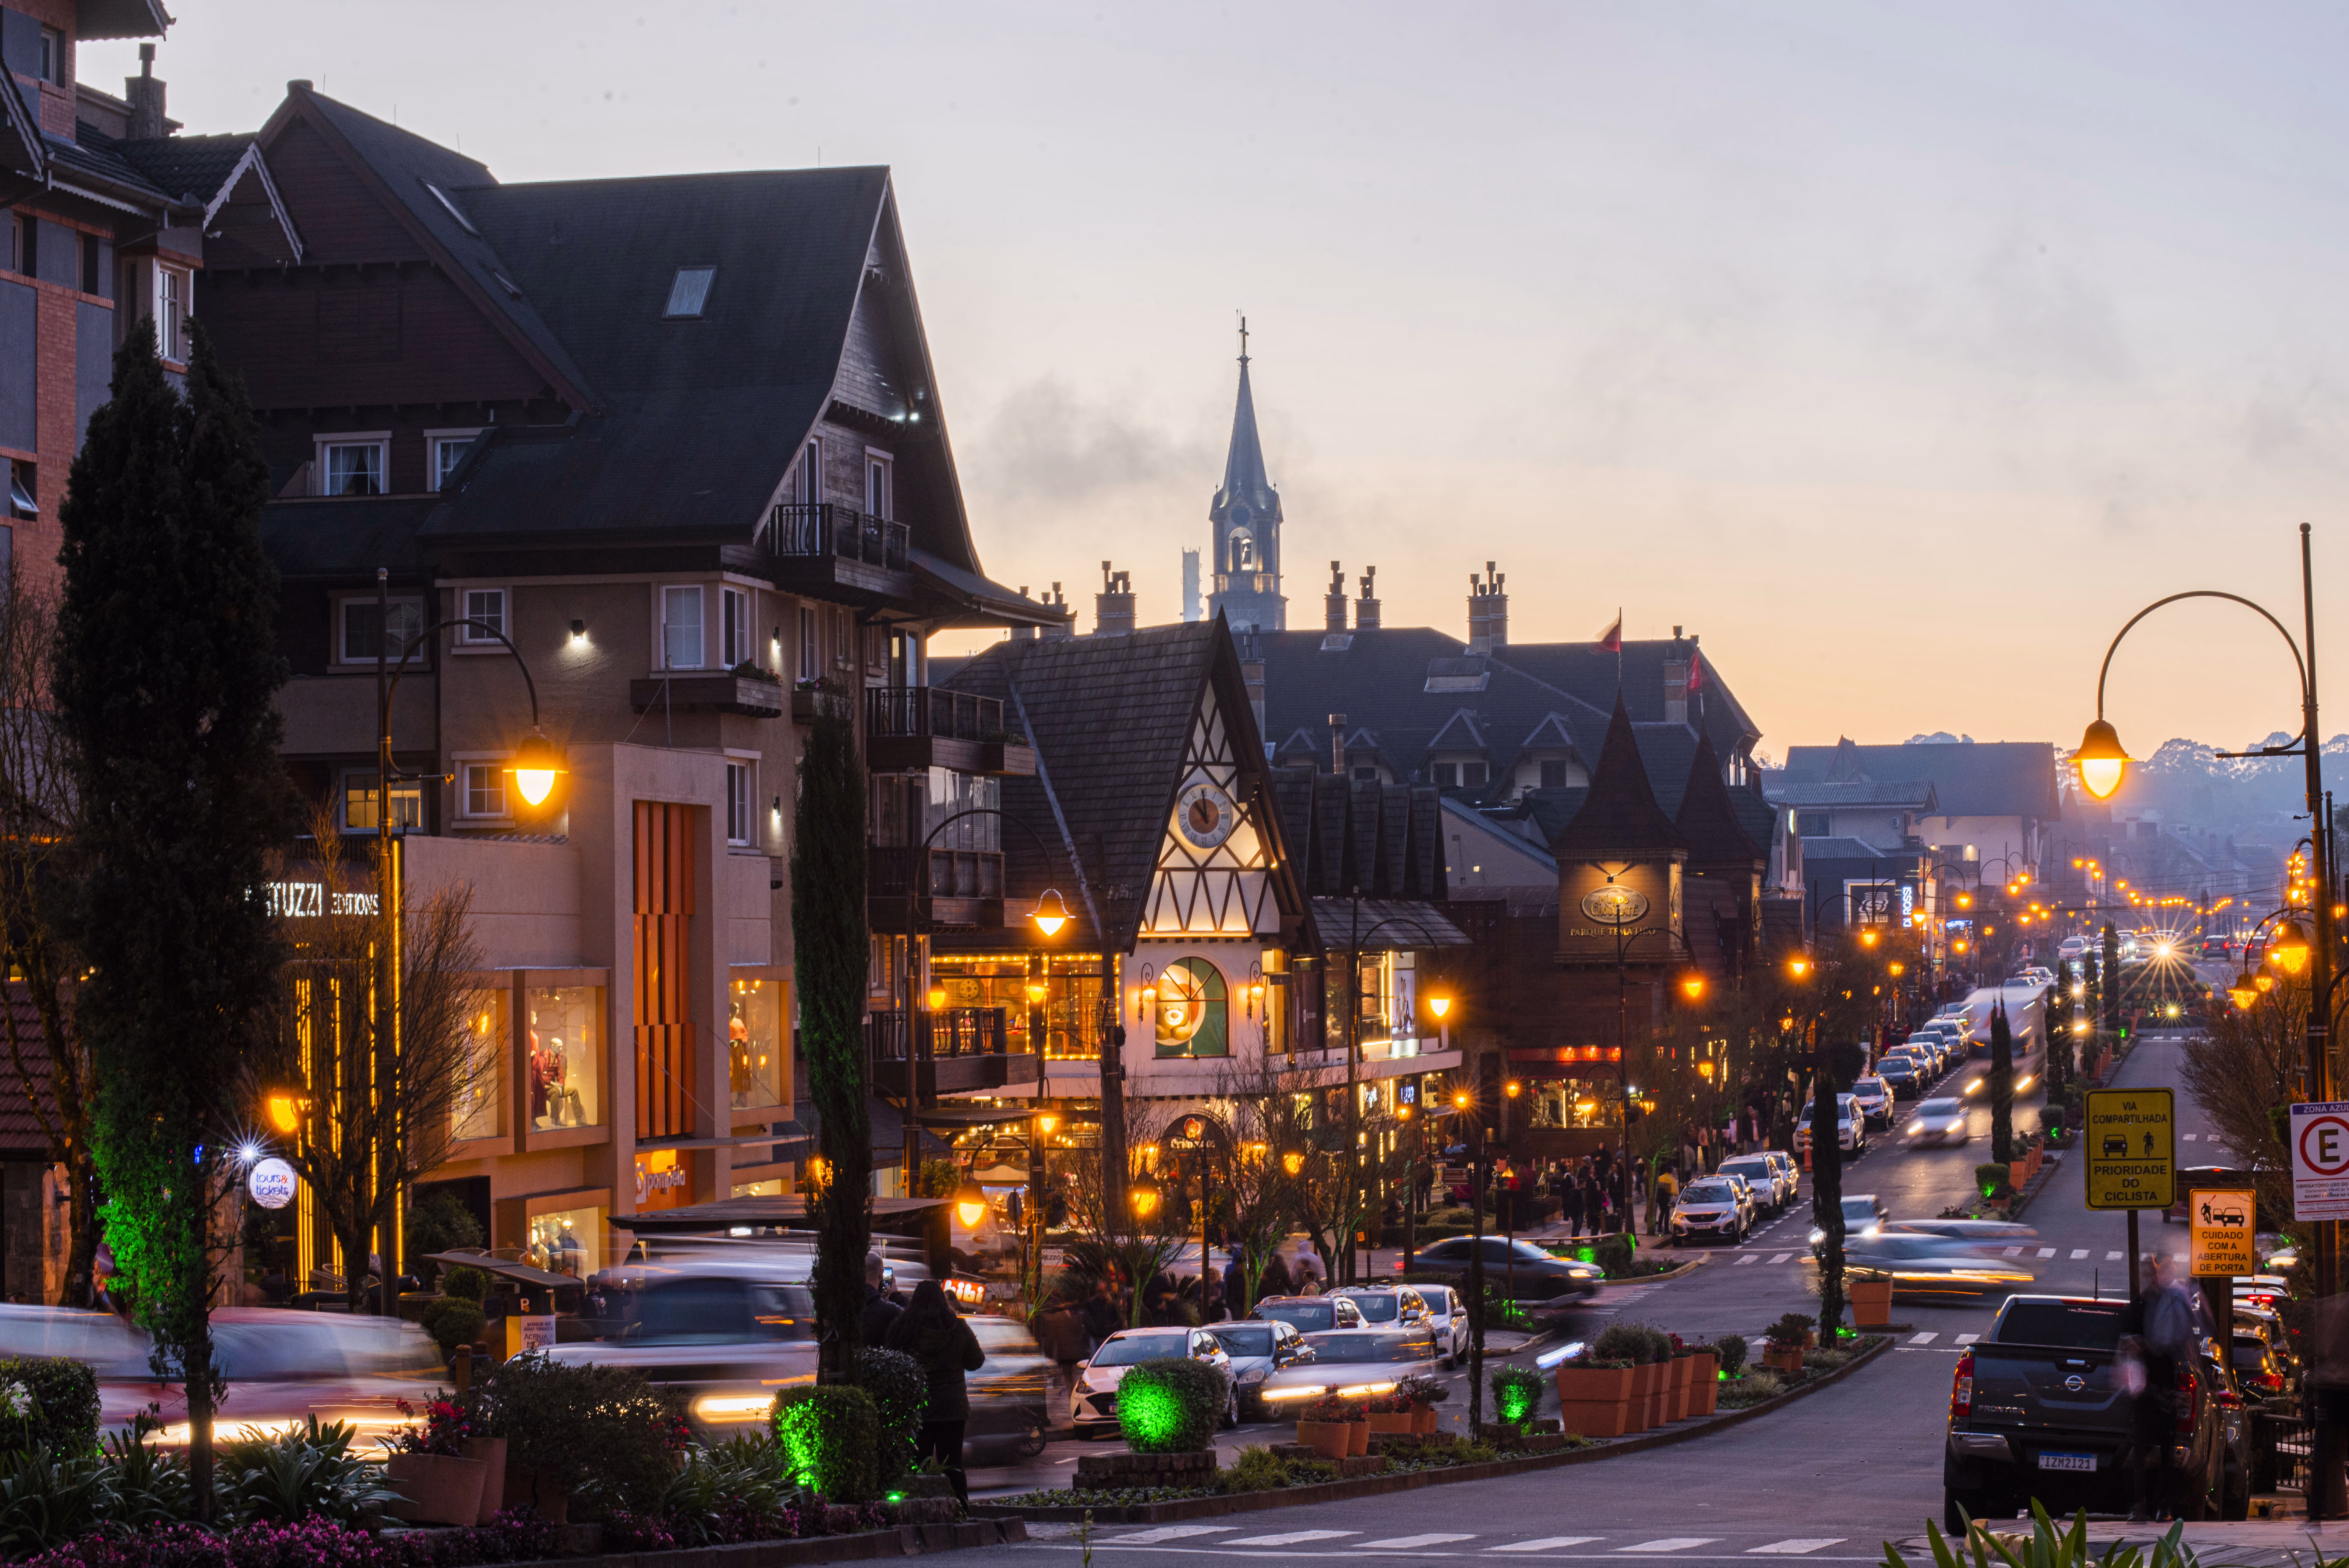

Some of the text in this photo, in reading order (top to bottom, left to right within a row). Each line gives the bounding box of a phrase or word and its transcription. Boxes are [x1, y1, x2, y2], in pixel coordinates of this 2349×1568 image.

[245, 882, 322, 917] TUZZI
[1903, 887, 1912, 915] ROSSI
[1570, 927, 1656, 937] PARQUE TEMÁTICO
[2123, 1101, 2137, 1110] VIA
[2092, 1114, 2167, 1124] COMPARTILHADA
[2319, 1129, 2340, 1163] E
[2094, 1165, 2167, 1175] PRIORIDADE
[2122, 1179, 2139, 1188] DO
[256, 1185, 289, 1195] tickets
[2105, 1191, 2157, 1201] CICLISTA
[2197, 1253, 2247, 1261] ABERTURA
[520, 1298, 529, 1311] P
[1978, 1405, 2025, 1414] FRONTIER
[2045, 1457, 2091, 1470] IZM2I21
